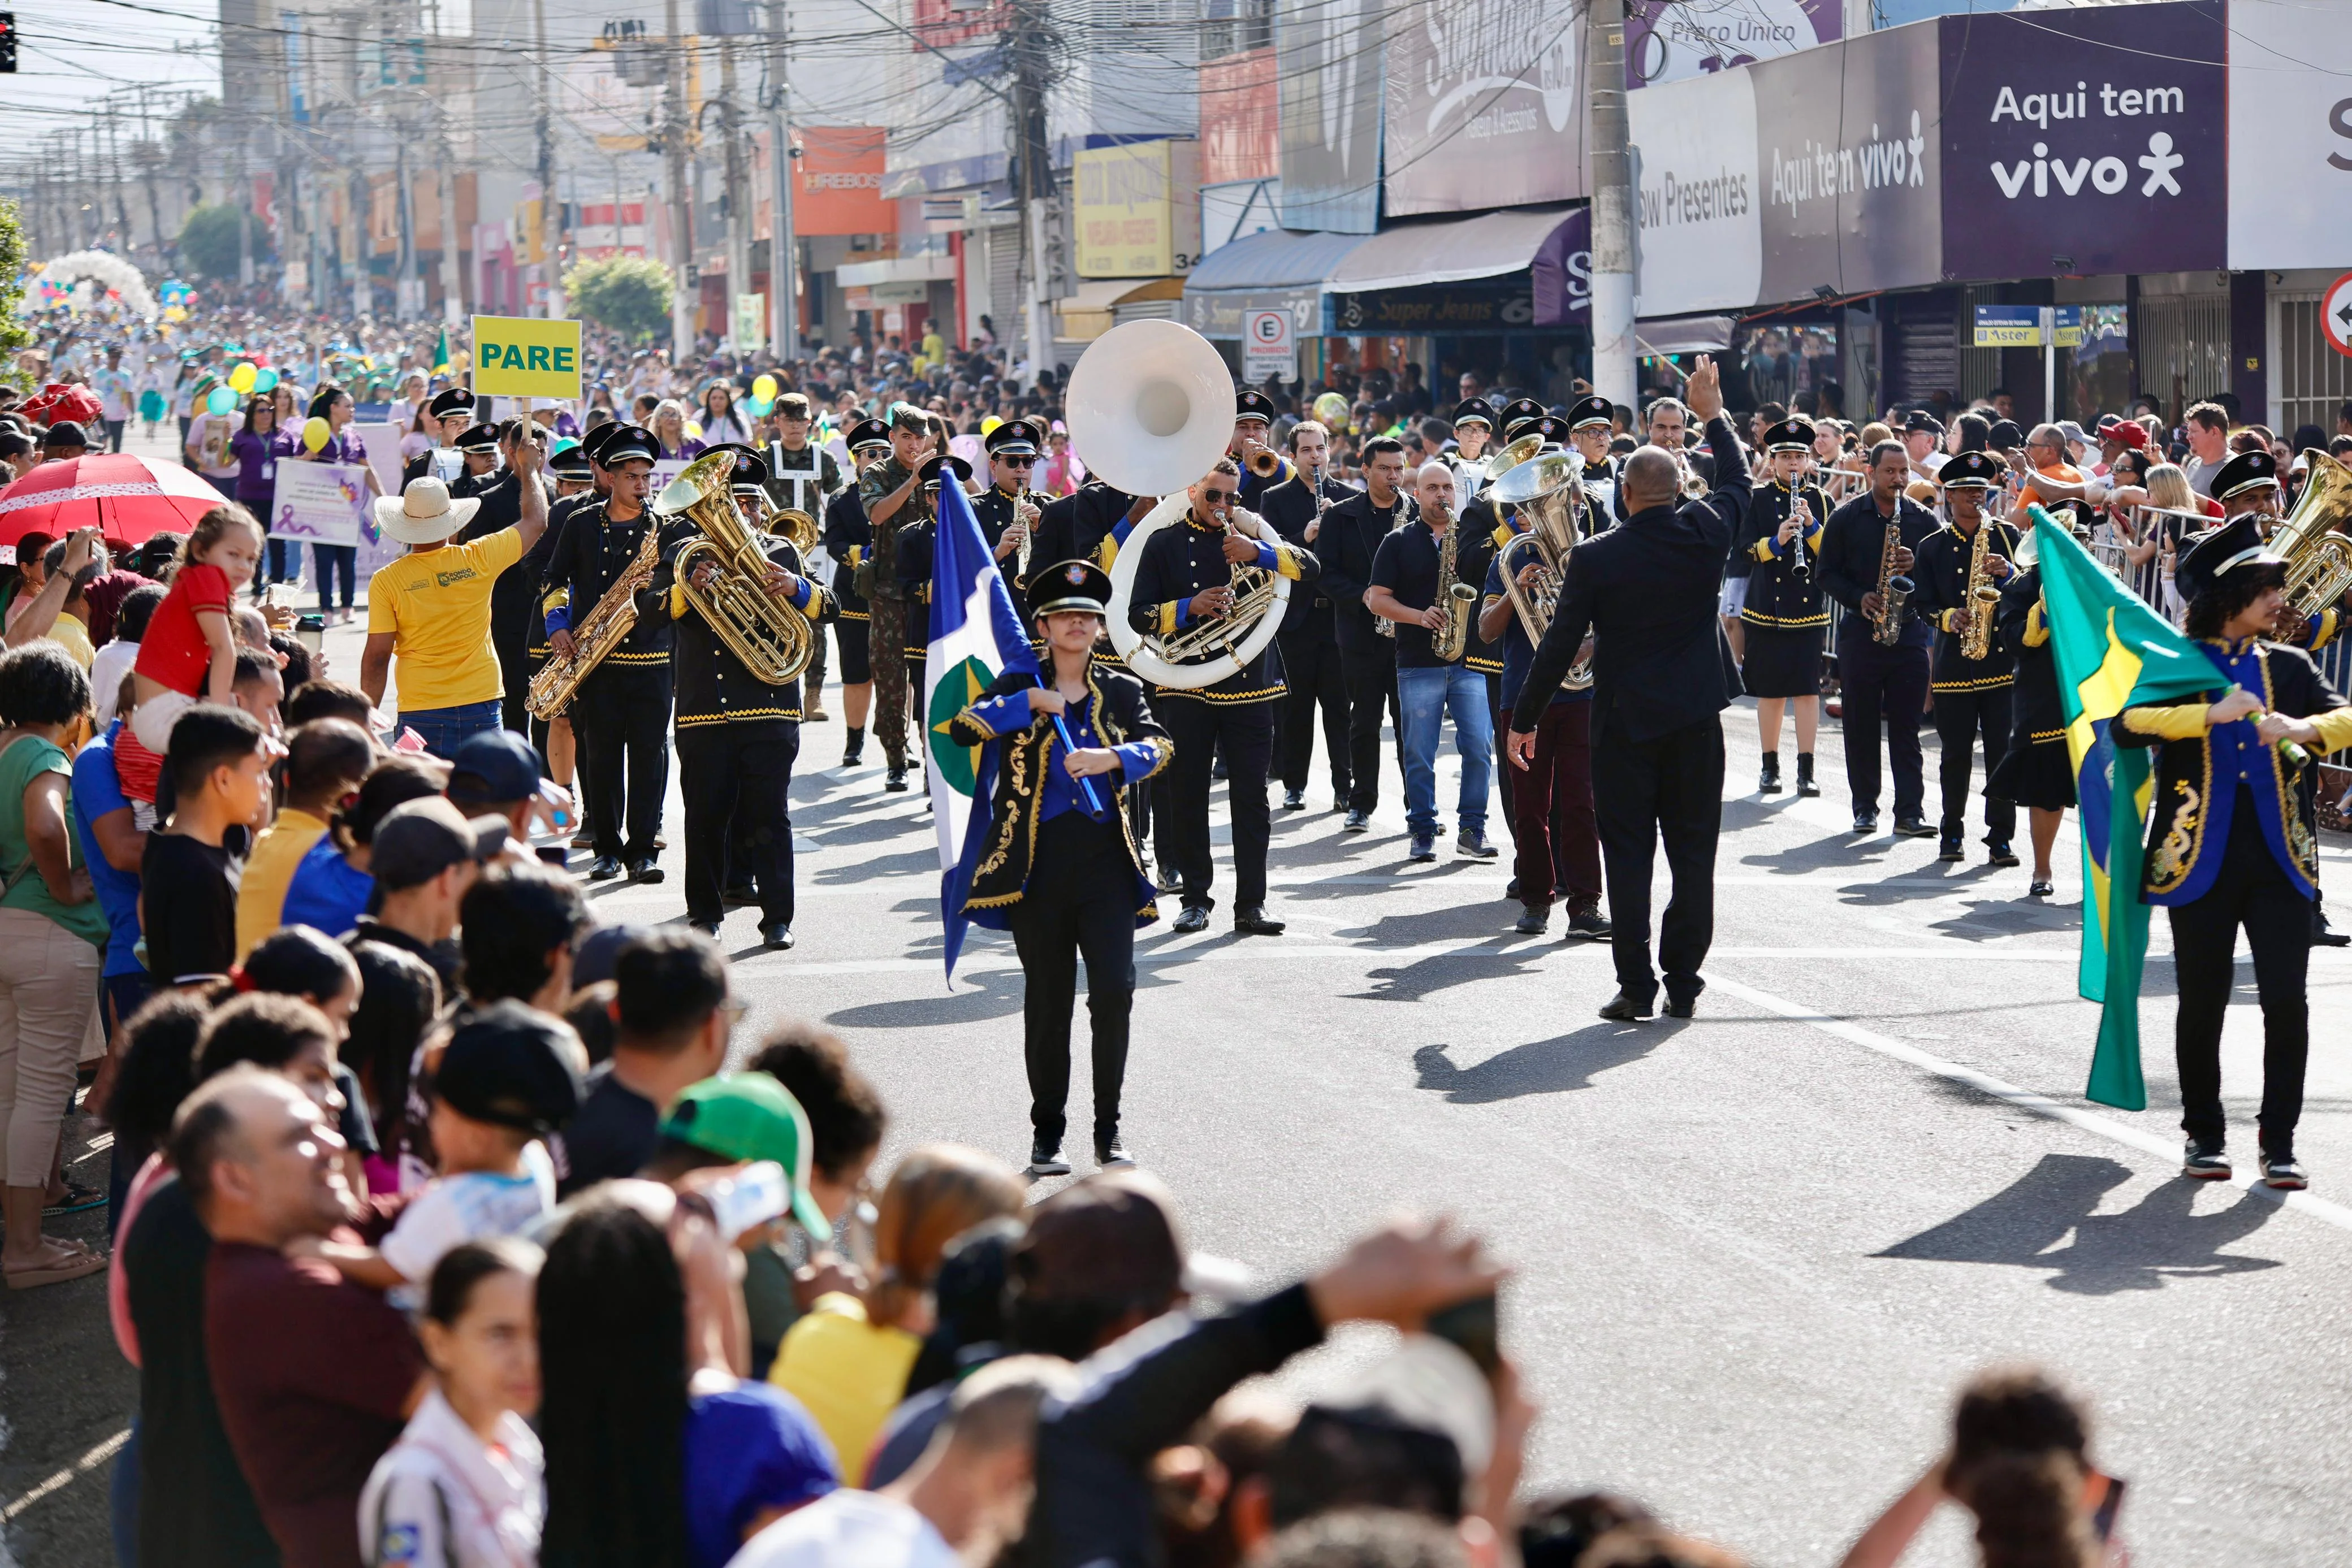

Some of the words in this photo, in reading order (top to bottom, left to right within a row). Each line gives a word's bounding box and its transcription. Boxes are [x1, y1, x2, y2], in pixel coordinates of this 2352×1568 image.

[1737, 16, 1795, 41] Único
[1990, 81, 2086, 129] Aqui
[2099, 83, 2184, 116] tem
[1771, 138, 1813, 219] Aqui
[1815, 142, 1854, 198] tem
[1859, 123, 1906, 190] vivo
[1990, 141, 2128, 198] vivo
[1665, 165, 1748, 226] Presentes
[1378, 294, 1433, 327] Super
[1435, 294, 1493, 320] Jeans
[1263, 321, 1275, 336] E
[1990, 330, 2030, 341] Aster
[481, 343, 574, 372] PARE
[449, 568, 472, 577] RONDO
